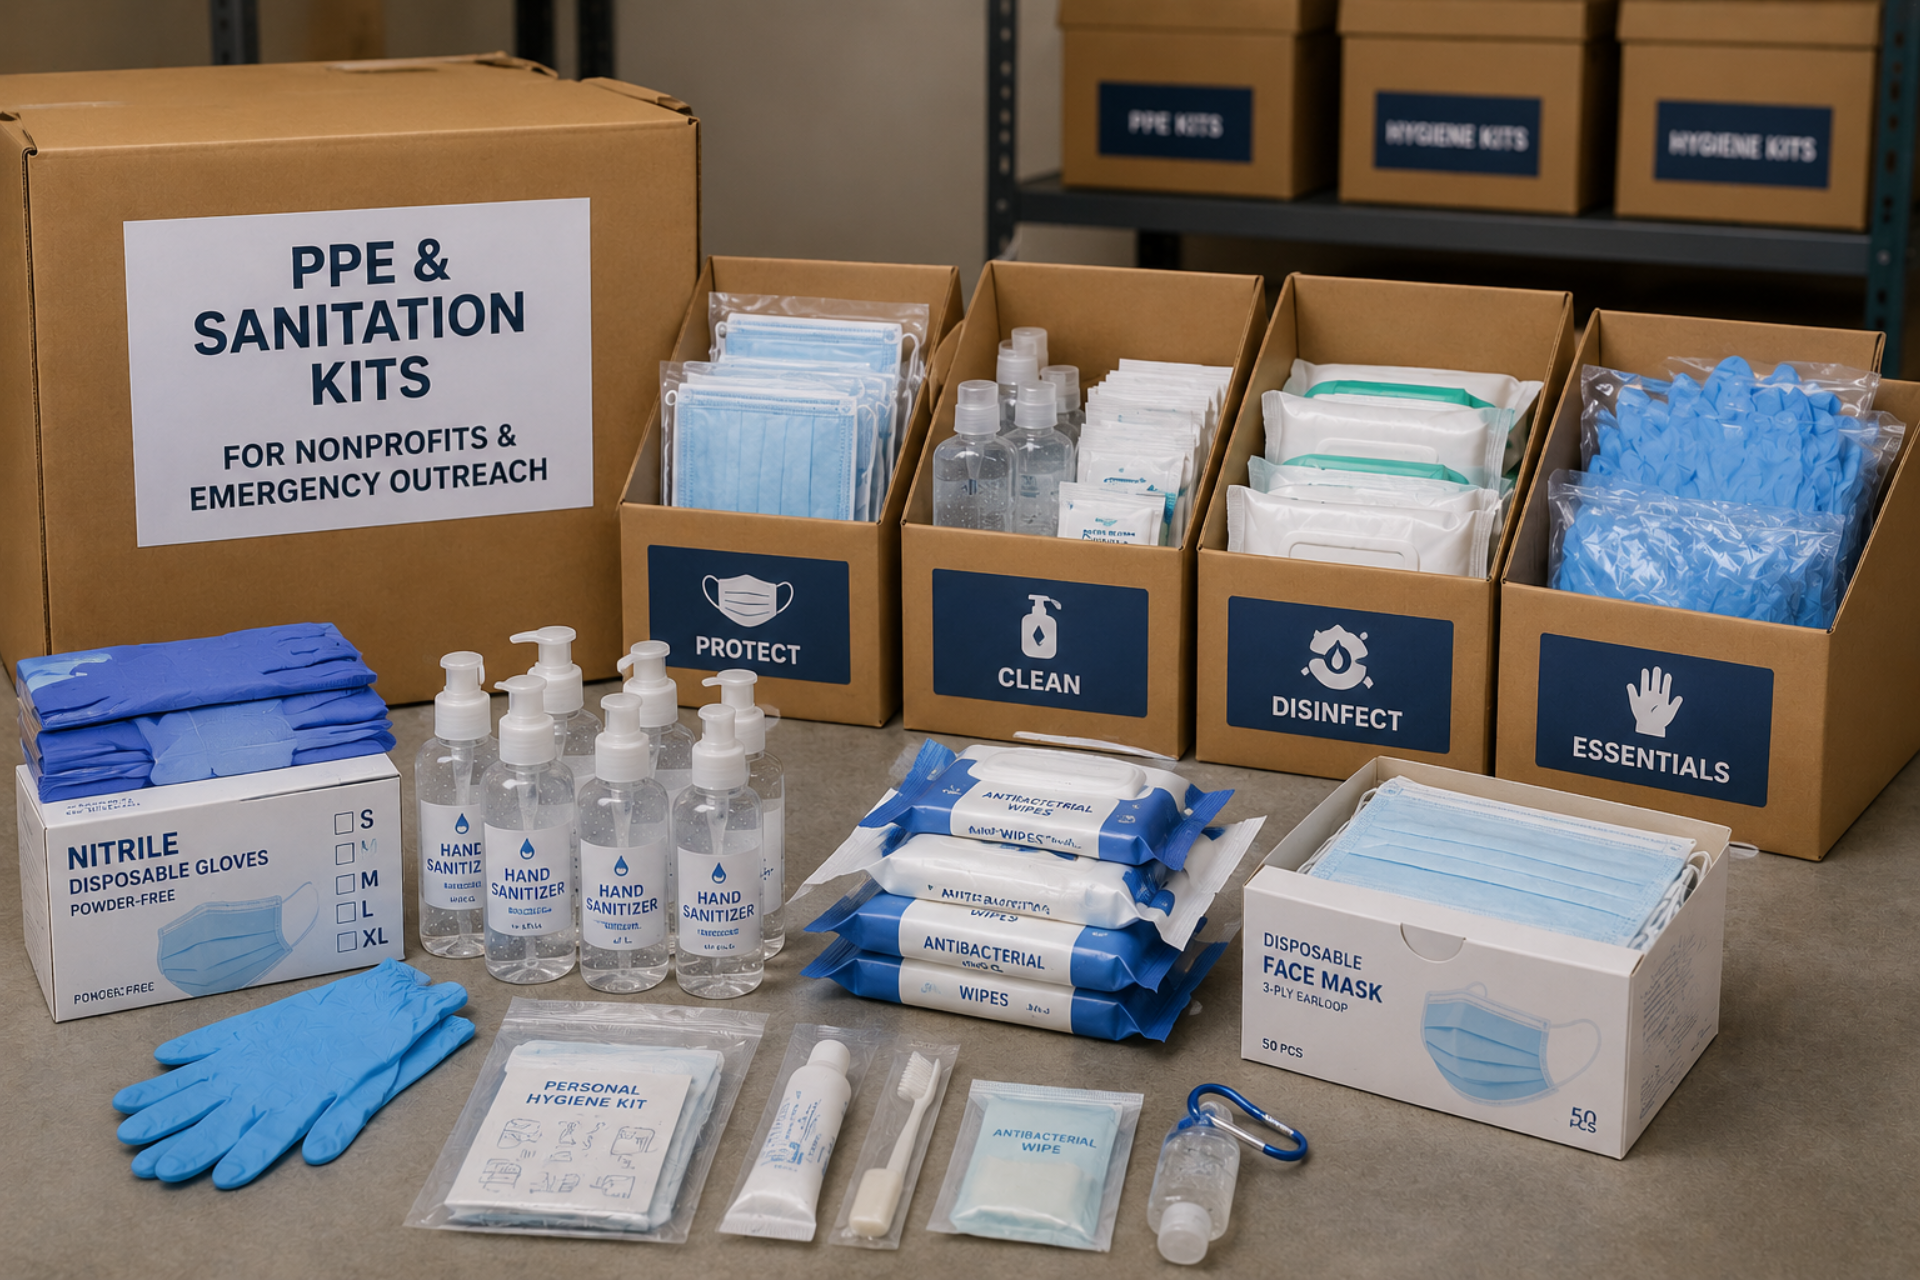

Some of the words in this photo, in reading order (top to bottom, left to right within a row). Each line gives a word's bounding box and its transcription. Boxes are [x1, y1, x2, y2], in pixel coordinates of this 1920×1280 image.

[1385, 119, 1476, 149] HYGIENE
[1479, 124, 1529, 152] KITS
[1669, 129, 1763, 160] HYGIENE
[1765, 134, 1817, 163] KITS
[291, 240, 396, 290] PPE
[413, 237, 452, 283] &
[193, 290, 525, 357] SANITATION
[310, 354, 432, 406] KITS
[222, 442, 286, 471] FOR
[294, 425, 489, 465] NONPROFITS
[496, 423, 518, 448] &
[189, 471, 382, 511] EMERGENCY
[388, 457, 548, 495] OUTREACH
[696, 635, 801, 666] PROTECT
[997, 666, 1081, 696] CLEAN
[1271, 695, 1403, 732] DISINFECT
[1572, 735, 1731, 785] ESSENTIALS
[360, 808, 375, 829] S
[1007, 803, 1054, 817] WIPES
[68, 832, 179, 870] NITRILE
[68, 861, 191, 896] DISPOSABLE
[194, 849, 270, 876] GLOVES
[361, 869, 380, 890] M
[426, 858, 481, 876] SANITIZ
[504, 867, 551, 883] HAND
[70, 889, 175, 916] POWDER-FREE
[491, 881, 565, 901] SANITIZER
[598, 883, 644, 899] HAND
[697, 889, 742, 906] HAND
[362, 899, 375, 919] L
[586, 897, 659, 916] SANITIZER
[682, 903, 755, 923] SANITIZER
[362, 926, 390, 949] XL
[923, 935, 1046, 971] ANTIBACTERIAL
[1264, 932, 1362, 971] DISPOSABLE
[1263, 955, 1315, 986] FACE
[1321, 970, 1383, 1004] MASK
[959, 984, 1009, 1008] WIPES
[1262, 981, 1294, 999] 3-PLY
[1296, 990, 1349, 1013] EARLOOP
[1262, 1037, 1278, 1051] 50
[1280, 1042, 1304, 1058] PCS
[544, 1080, 640, 1096] PERSONAL
[526, 1093, 611, 1108] HYGIENE
[616, 1098, 647, 1110] KIT
[992, 1128, 1097, 1149] ANTIBACTERIAL
[1021, 1142, 1062, 1155] WIPE
